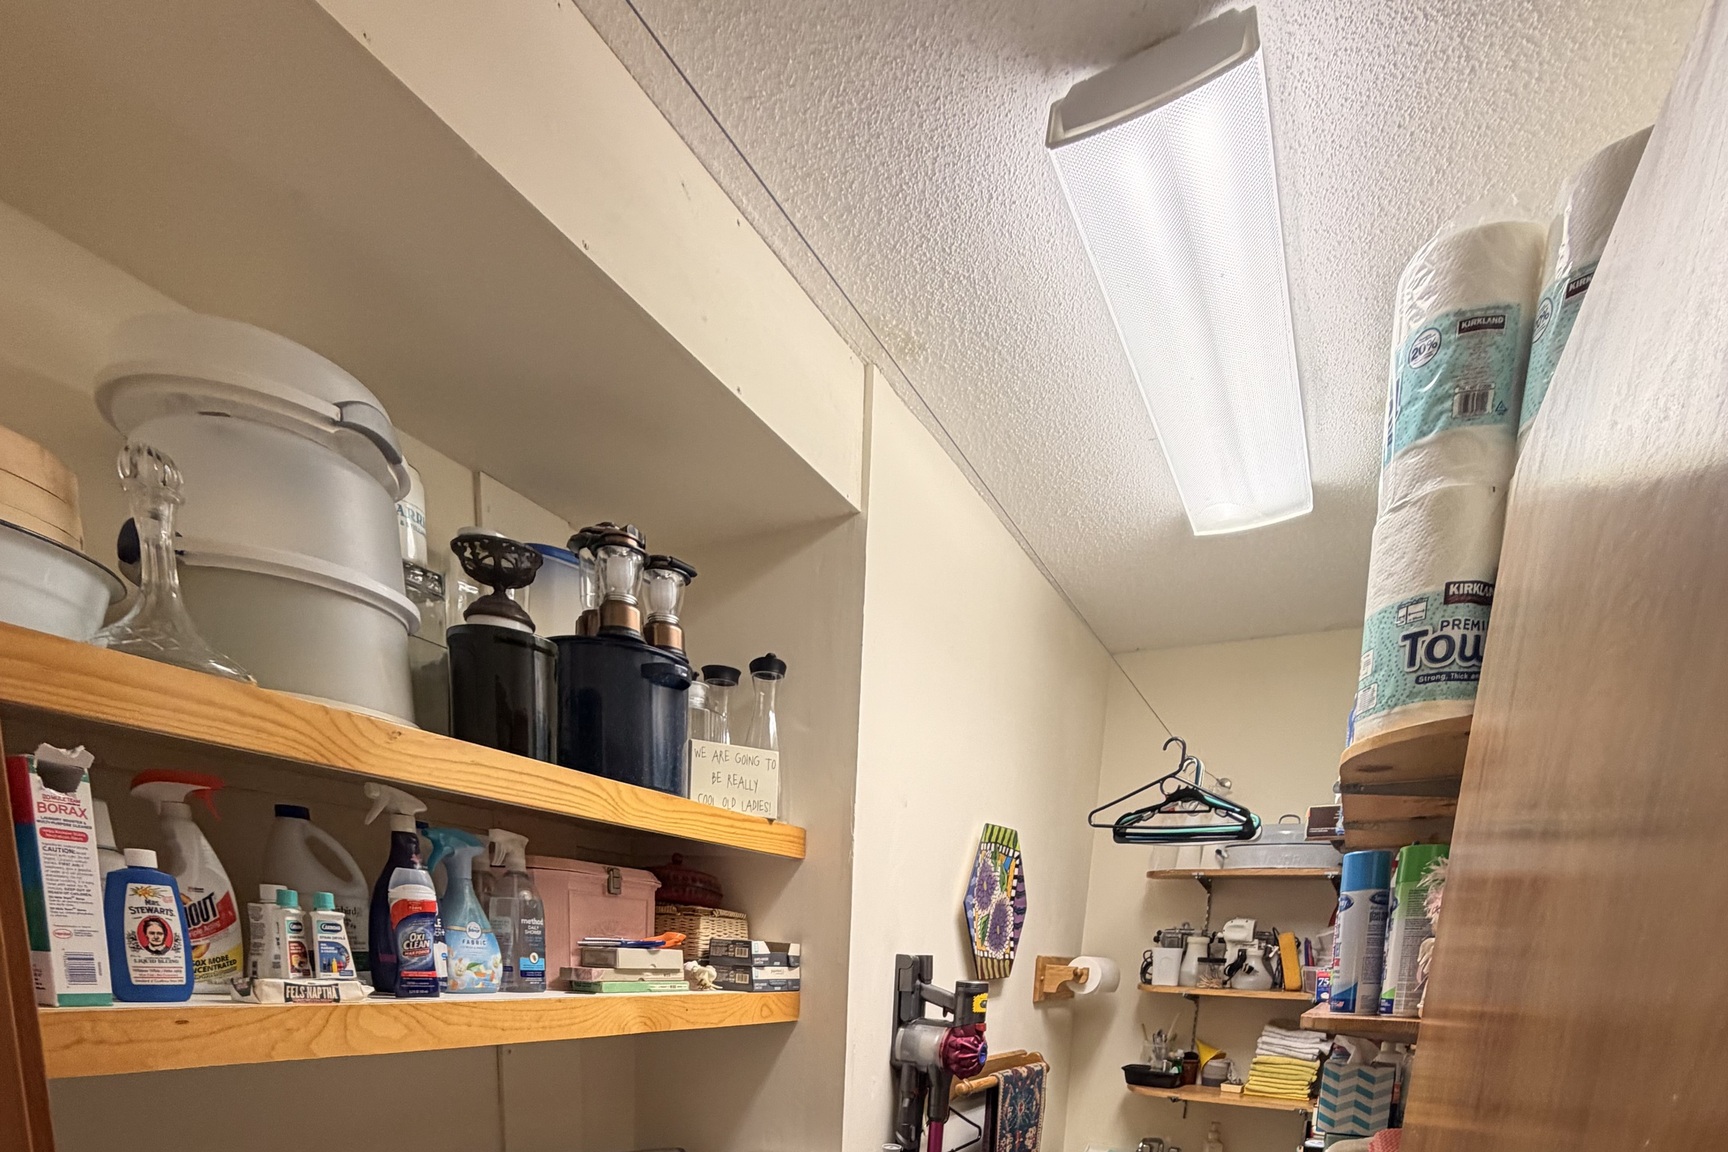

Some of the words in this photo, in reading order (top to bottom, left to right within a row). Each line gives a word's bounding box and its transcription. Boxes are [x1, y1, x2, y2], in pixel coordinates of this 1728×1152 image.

[1569, 274, 1594, 292] KIRK
[1460, 315, 1504, 330] KIRKLAND
[1411, 338, 1438, 362] 20%
[1449, 583, 1493, 597] KIRKLAN
[1440, 619, 1486, 631] PREMI
[1450, 672, 1468, 680] Thick
[694, 746, 707, 759] WE
[711, 749, 730, 764] ARE
[735, 752, 760, 767] GOING
[766, 758, 777, 771] TO
[711, 771, 722, 785] BE
[727, 773, 758, 793] REALLY
[37, 801, 88, 820] BORAX
[722, 797, 736, 810] OLD
[742, 800, 772, 816] LADIES!
[42, 845, 76, 856] CAUTION:
[184, 892, 218, 928] OUT
[521, 917, 544, 926] method
[410, 932, 426, 941] OXI
[462, 938, 487, 946] FABRIC
[403, 939, 431, 951] CLEAN
[194, 959, 237, 974] CENTRATED
[209, 955, 229, 964] MORE
[1318, 977, 1330, 986] 75
[286, 985, 338, 999] FELS-NAPTHA
